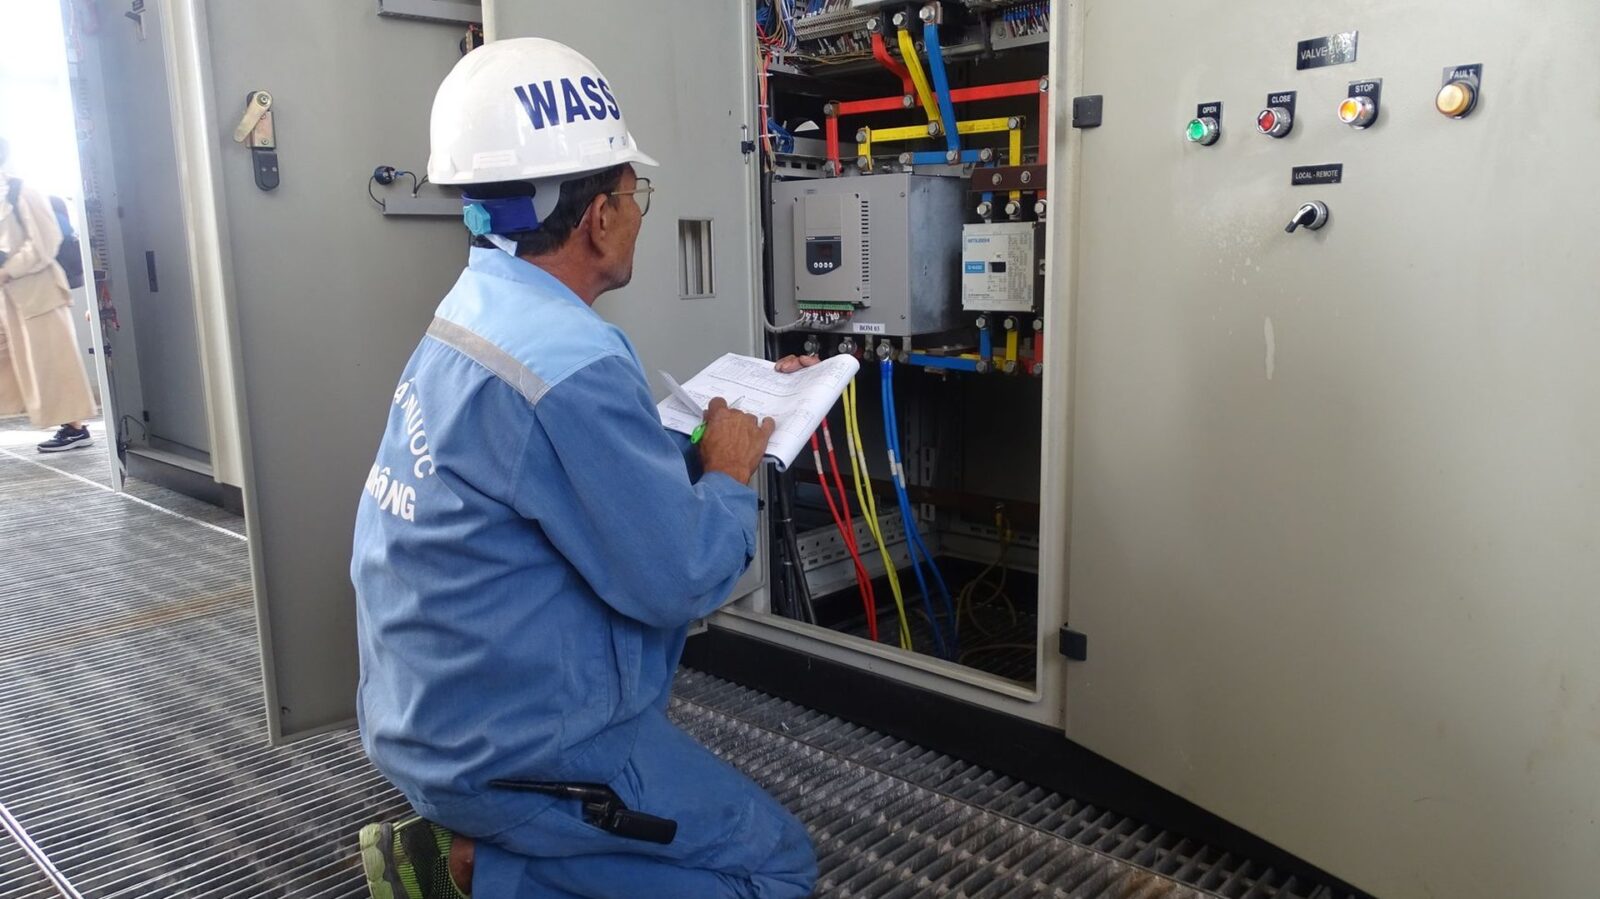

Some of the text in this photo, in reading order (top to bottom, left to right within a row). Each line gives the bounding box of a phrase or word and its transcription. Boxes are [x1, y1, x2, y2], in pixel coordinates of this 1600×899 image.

[1300, 46, 1328, 60] VALVE
[1449, 68, 1474, 79] FAULT
[1355, 83, 1374, 93] STOP
[514, 75, 621, 130] WASS
[1271, 94, 1291, 104] CLOSE
[1202, 106, 1217, 114] OPEN
